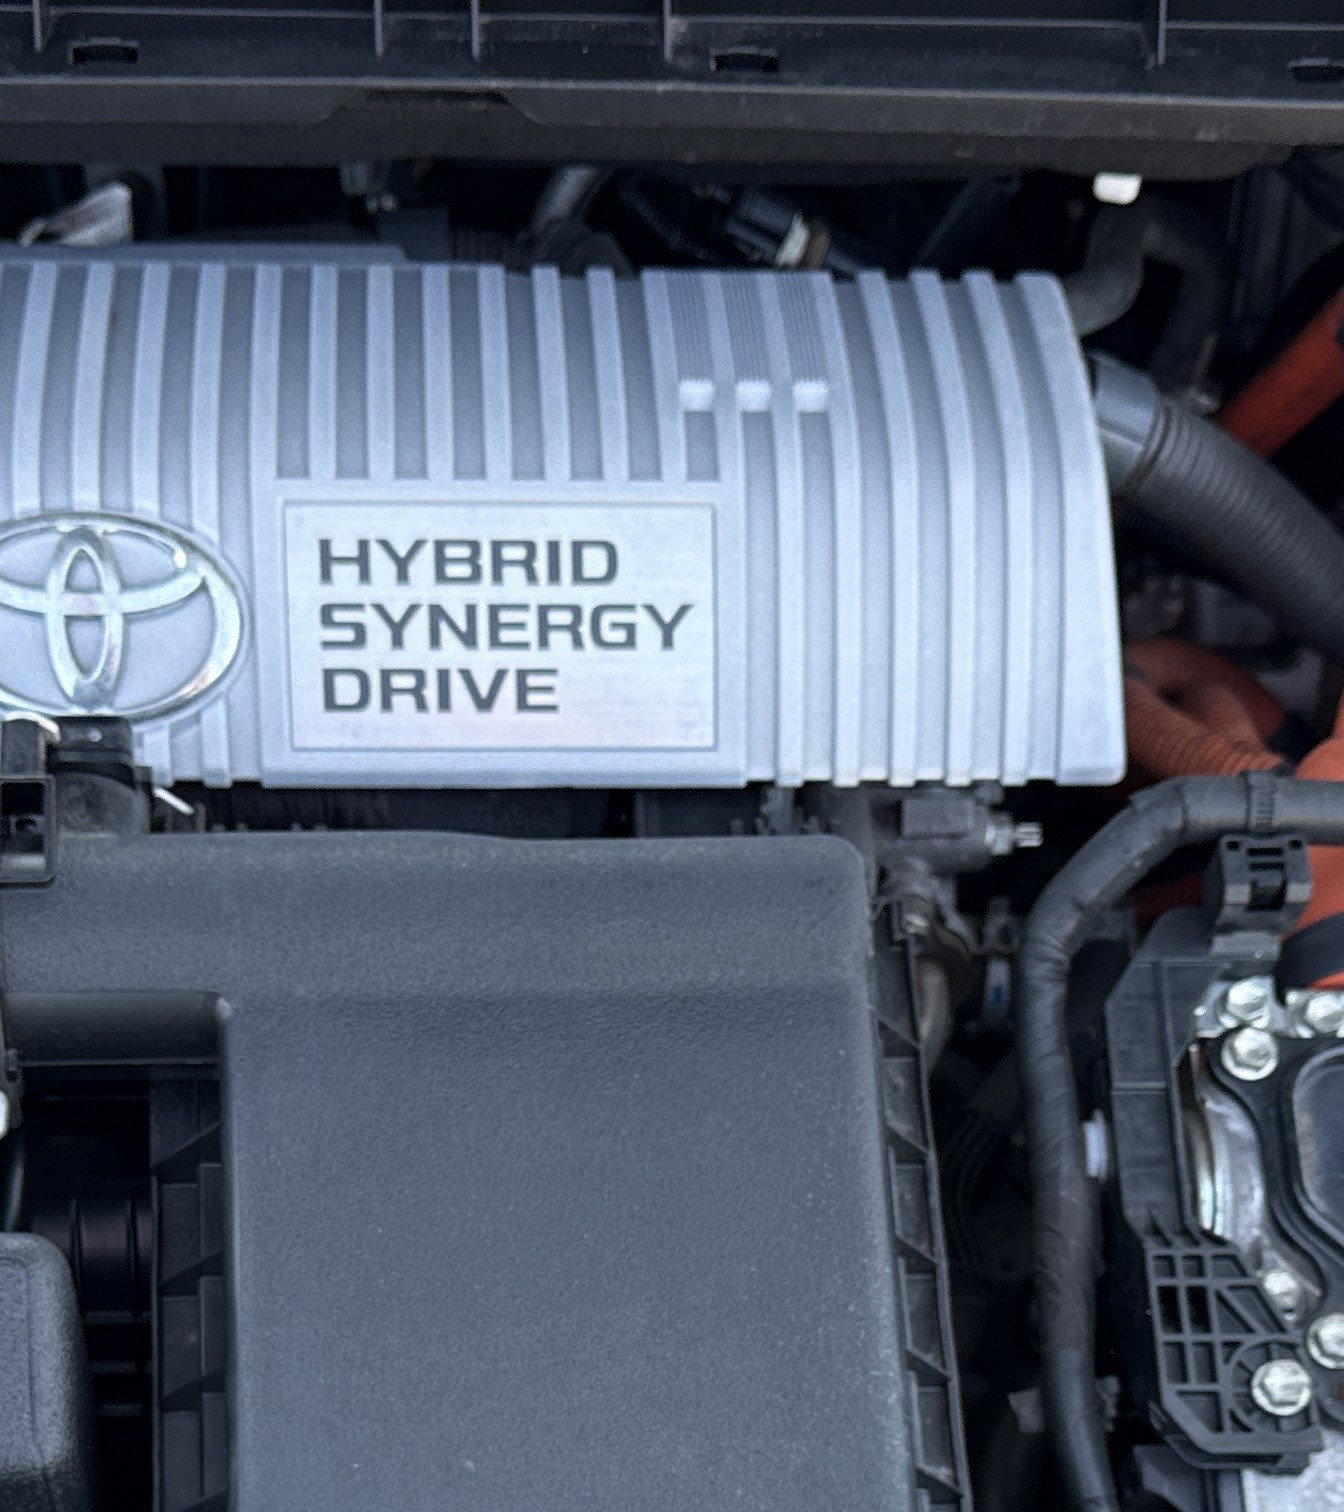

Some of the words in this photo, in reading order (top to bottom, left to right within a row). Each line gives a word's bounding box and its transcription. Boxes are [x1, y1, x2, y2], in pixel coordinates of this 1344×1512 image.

[318, 538, 619, 585] HYBRID
[320, 603, 693, 651] SYNERGY
[323, 667, 559, 713] DRIVE
